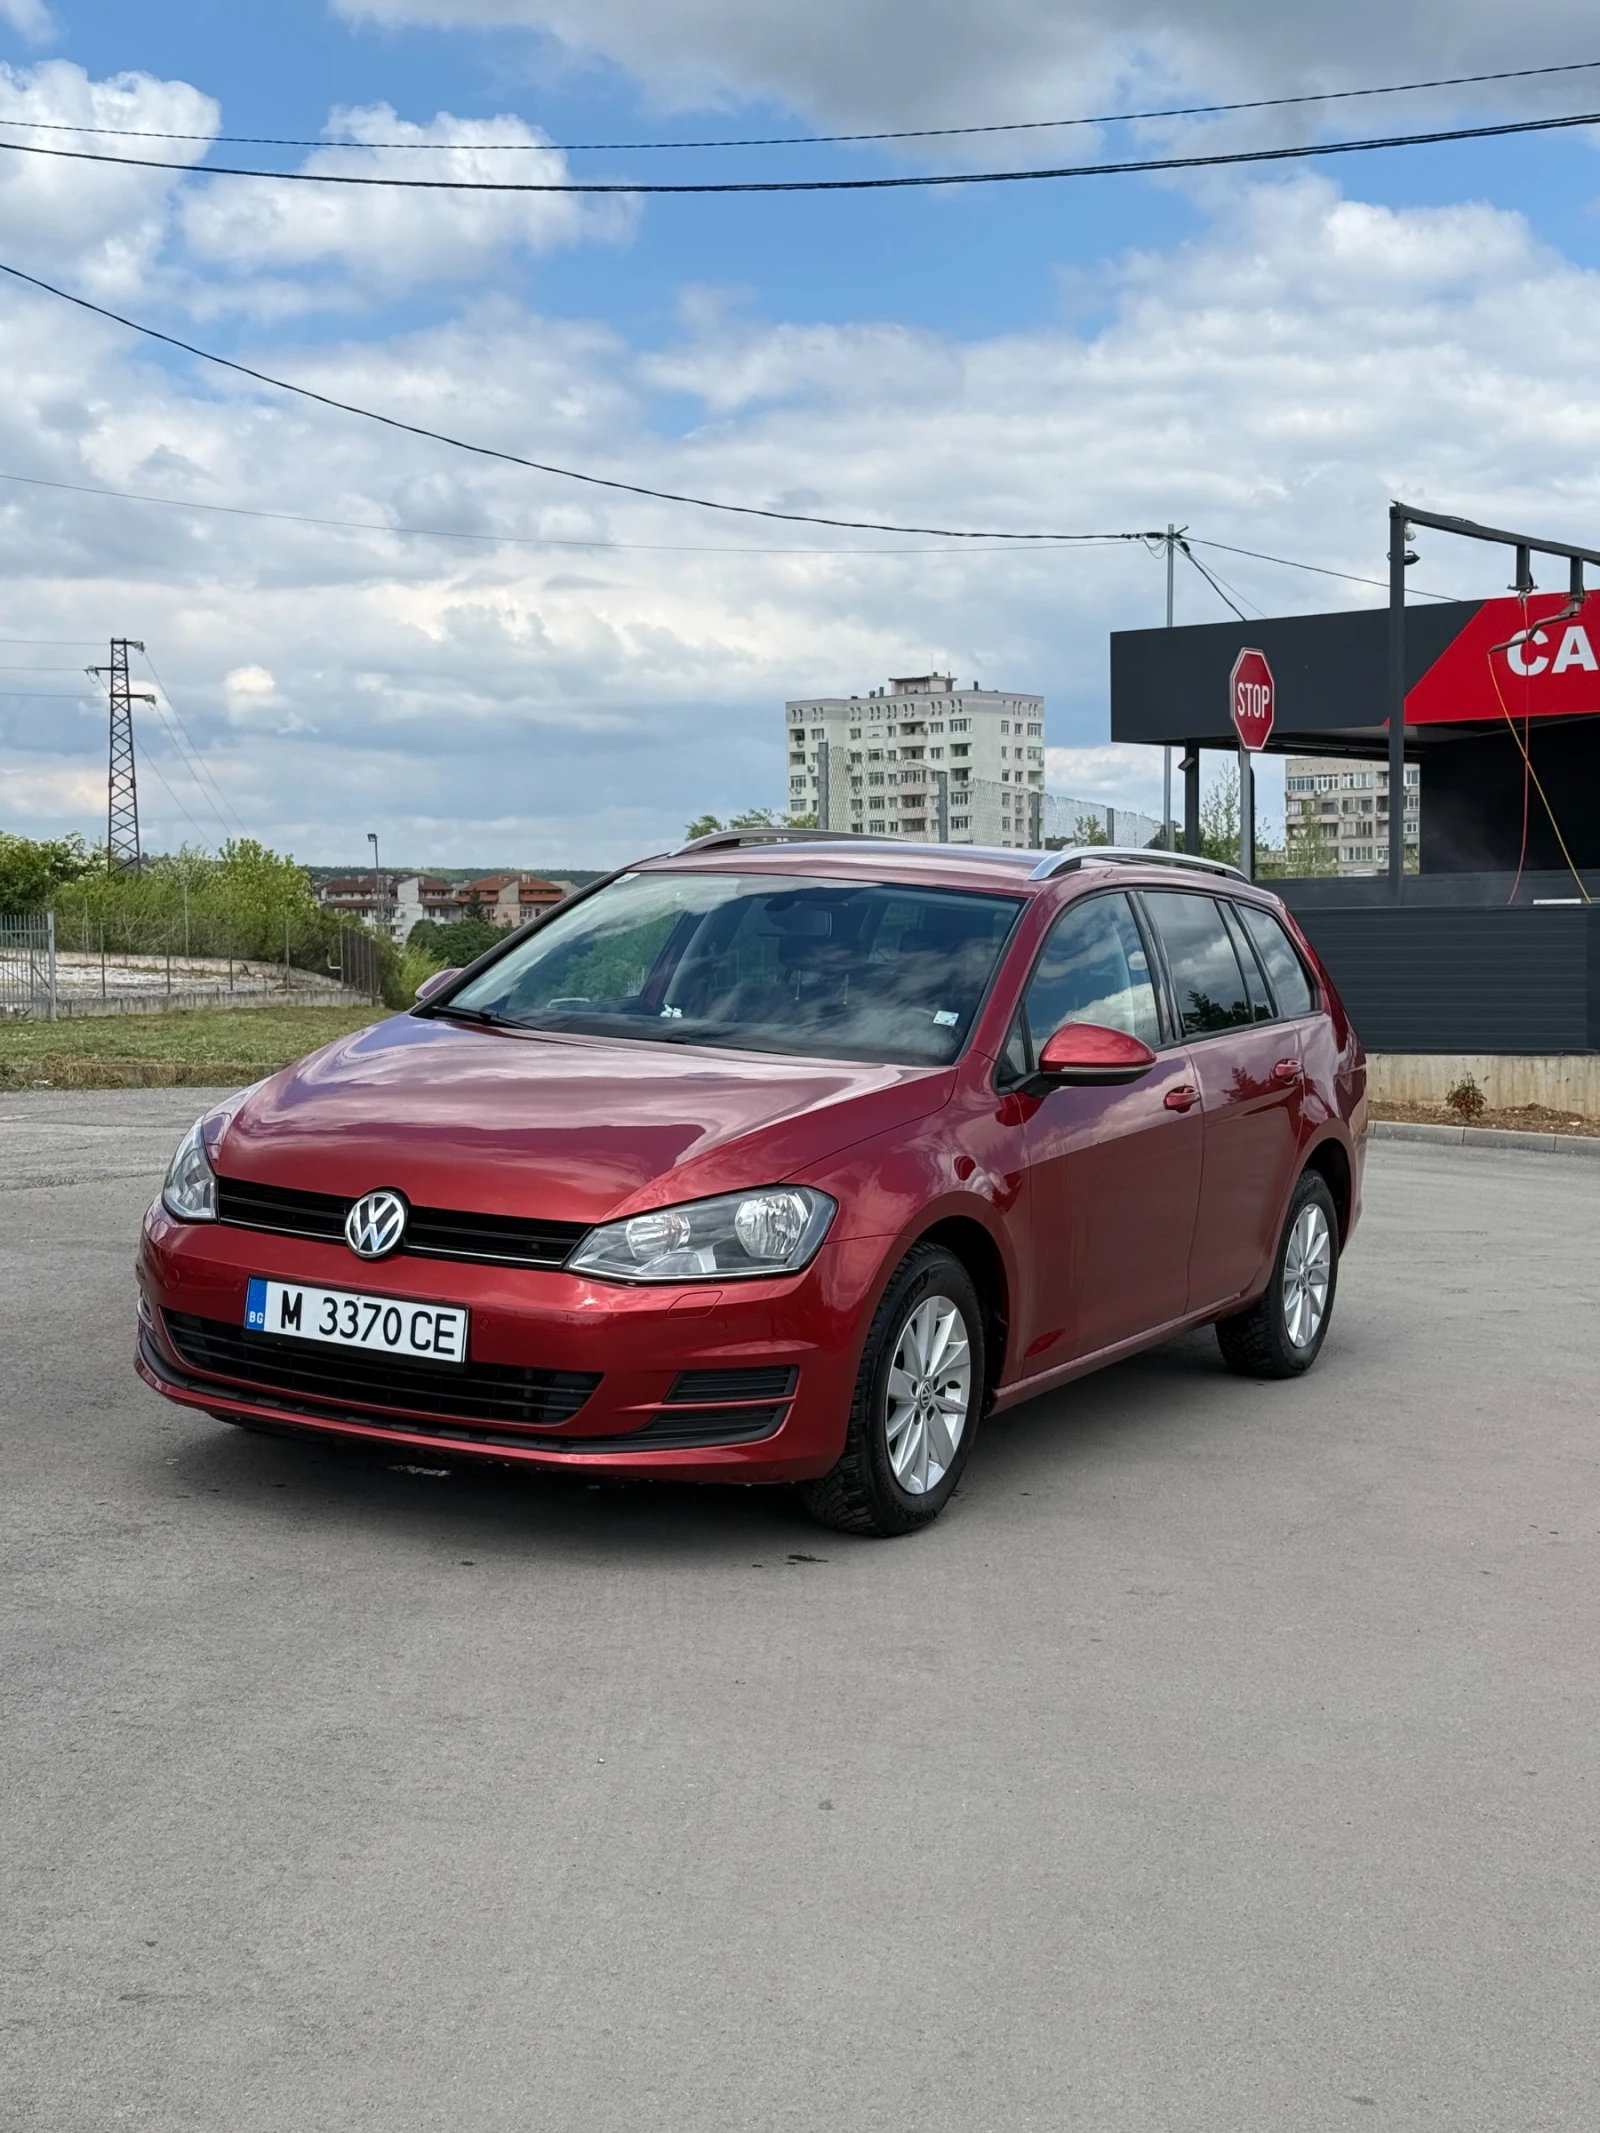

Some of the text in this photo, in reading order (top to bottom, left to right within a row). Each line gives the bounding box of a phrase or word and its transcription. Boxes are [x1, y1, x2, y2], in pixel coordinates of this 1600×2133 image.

[1506, 625, 1599, 676] CA
[1237, 681, 1270, 719] STOP
[249, 1310, 264, 1324] BG
[280, 1290, 457, 1356] M 3370 CE
